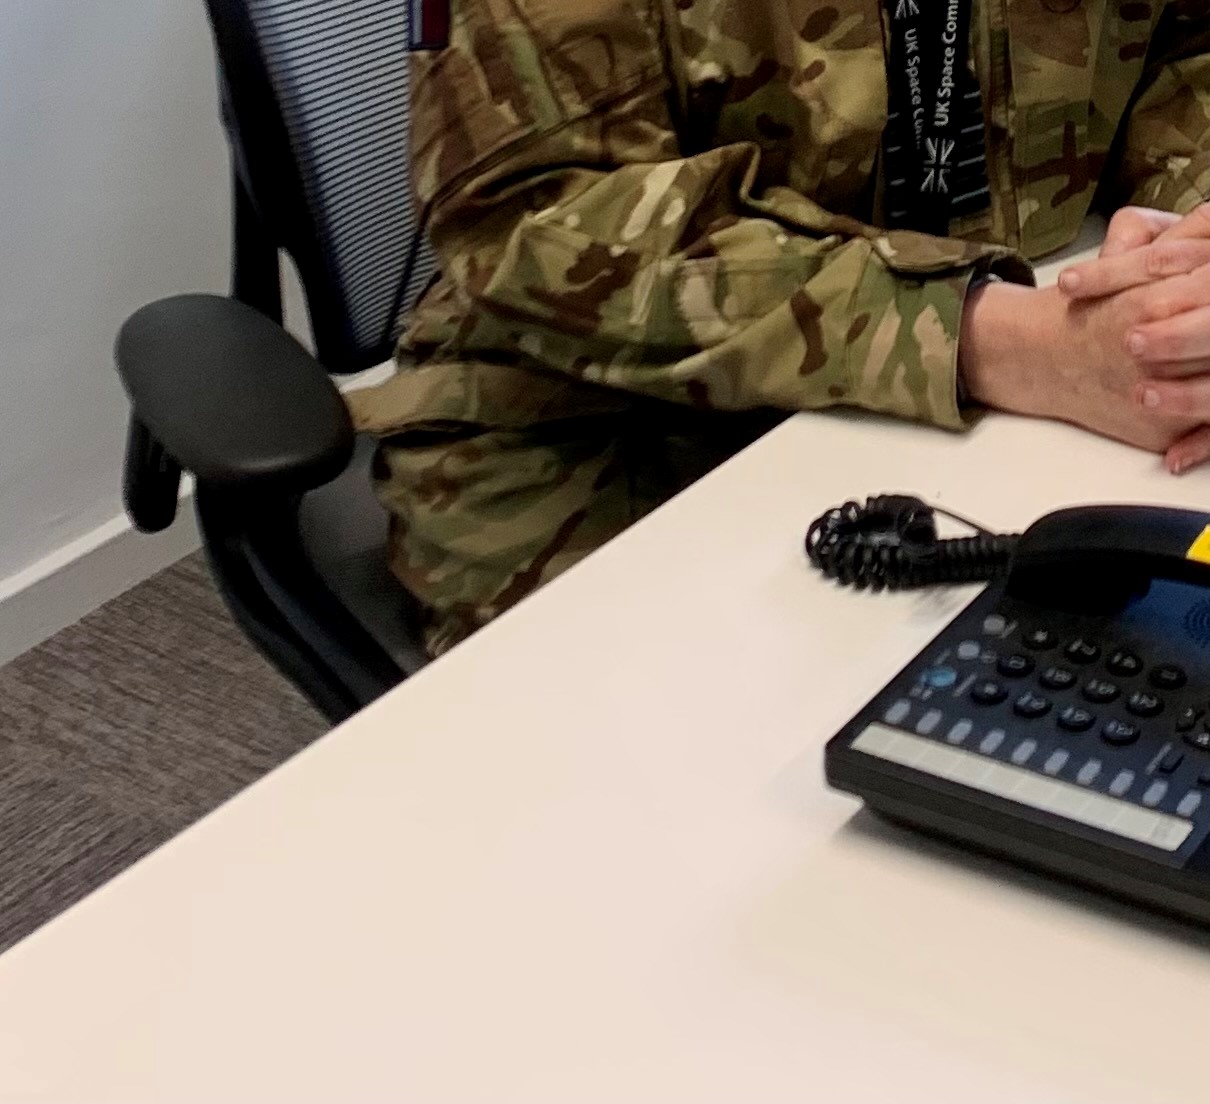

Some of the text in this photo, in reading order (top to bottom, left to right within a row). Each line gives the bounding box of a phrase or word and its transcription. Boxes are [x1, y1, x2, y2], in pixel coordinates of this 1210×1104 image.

[904, 28, 920, 54] UK
[905, 55, 922, 106] Space
[937, 45, 956, 100] Space
[934, 100, 951, 127] UK
